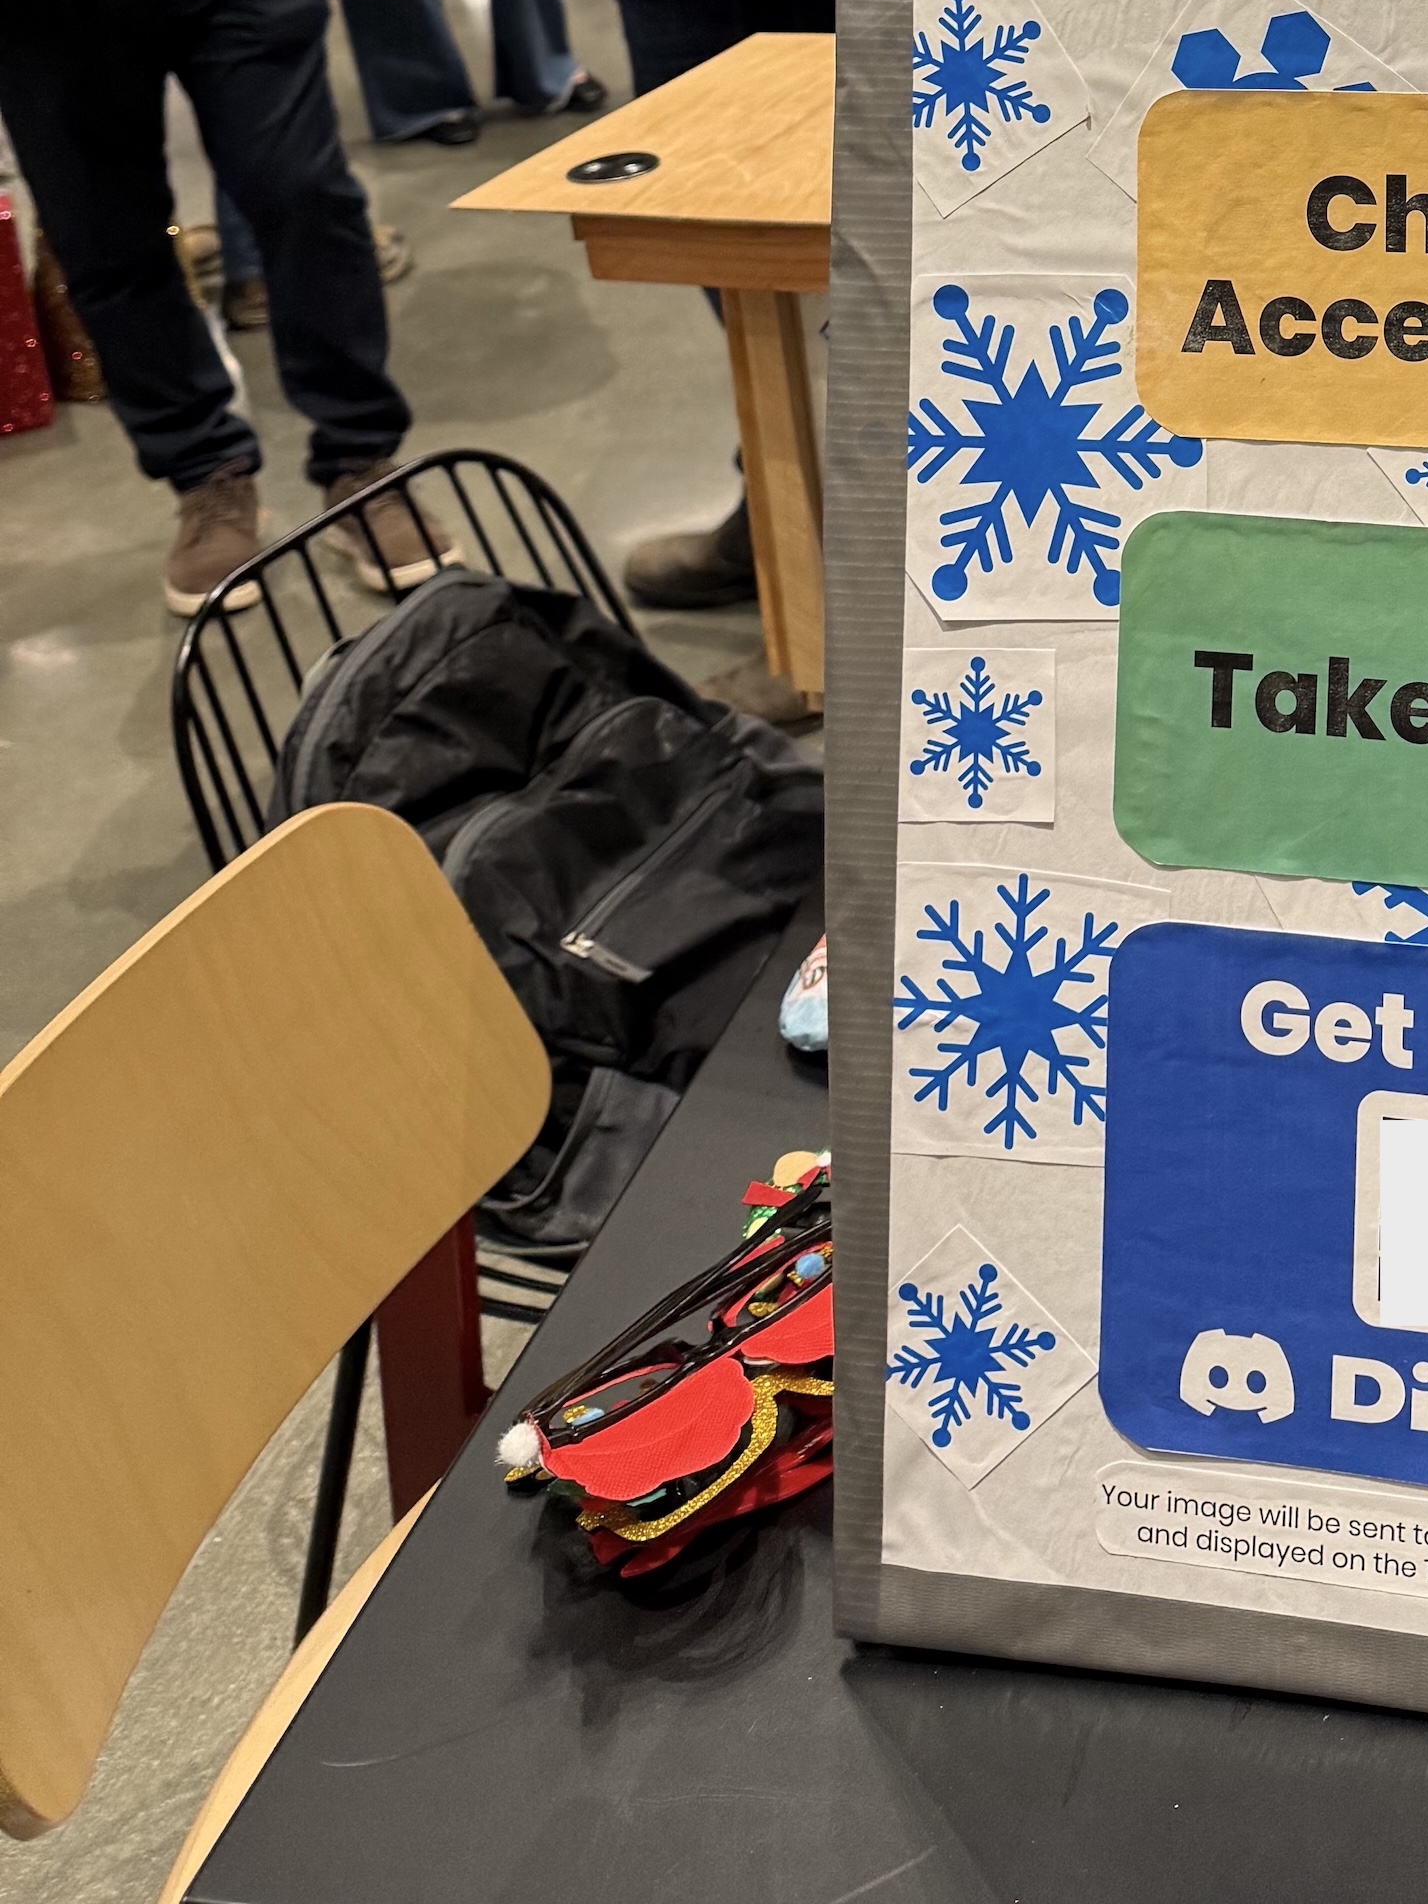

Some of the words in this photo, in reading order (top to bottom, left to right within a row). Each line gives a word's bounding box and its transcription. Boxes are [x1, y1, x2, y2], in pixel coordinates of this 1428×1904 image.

[1240, 979, 1414, 1070] Get
[1102, 1483, 1160, 1510] Your
[1167, 1490, 1251, 1526] image
[1259, 1505, 1299, 1529] will
[1307, 1509, 1341, 1534] be
[1349, 1520, 1406, 1543] sent
[1137, 1524, 1188, 1548] and
[1196, 1530, 1324, 1567] displayed
[1332, 1550, 1366, 1572] on
[1373, 1552, 1417, 1578] the
